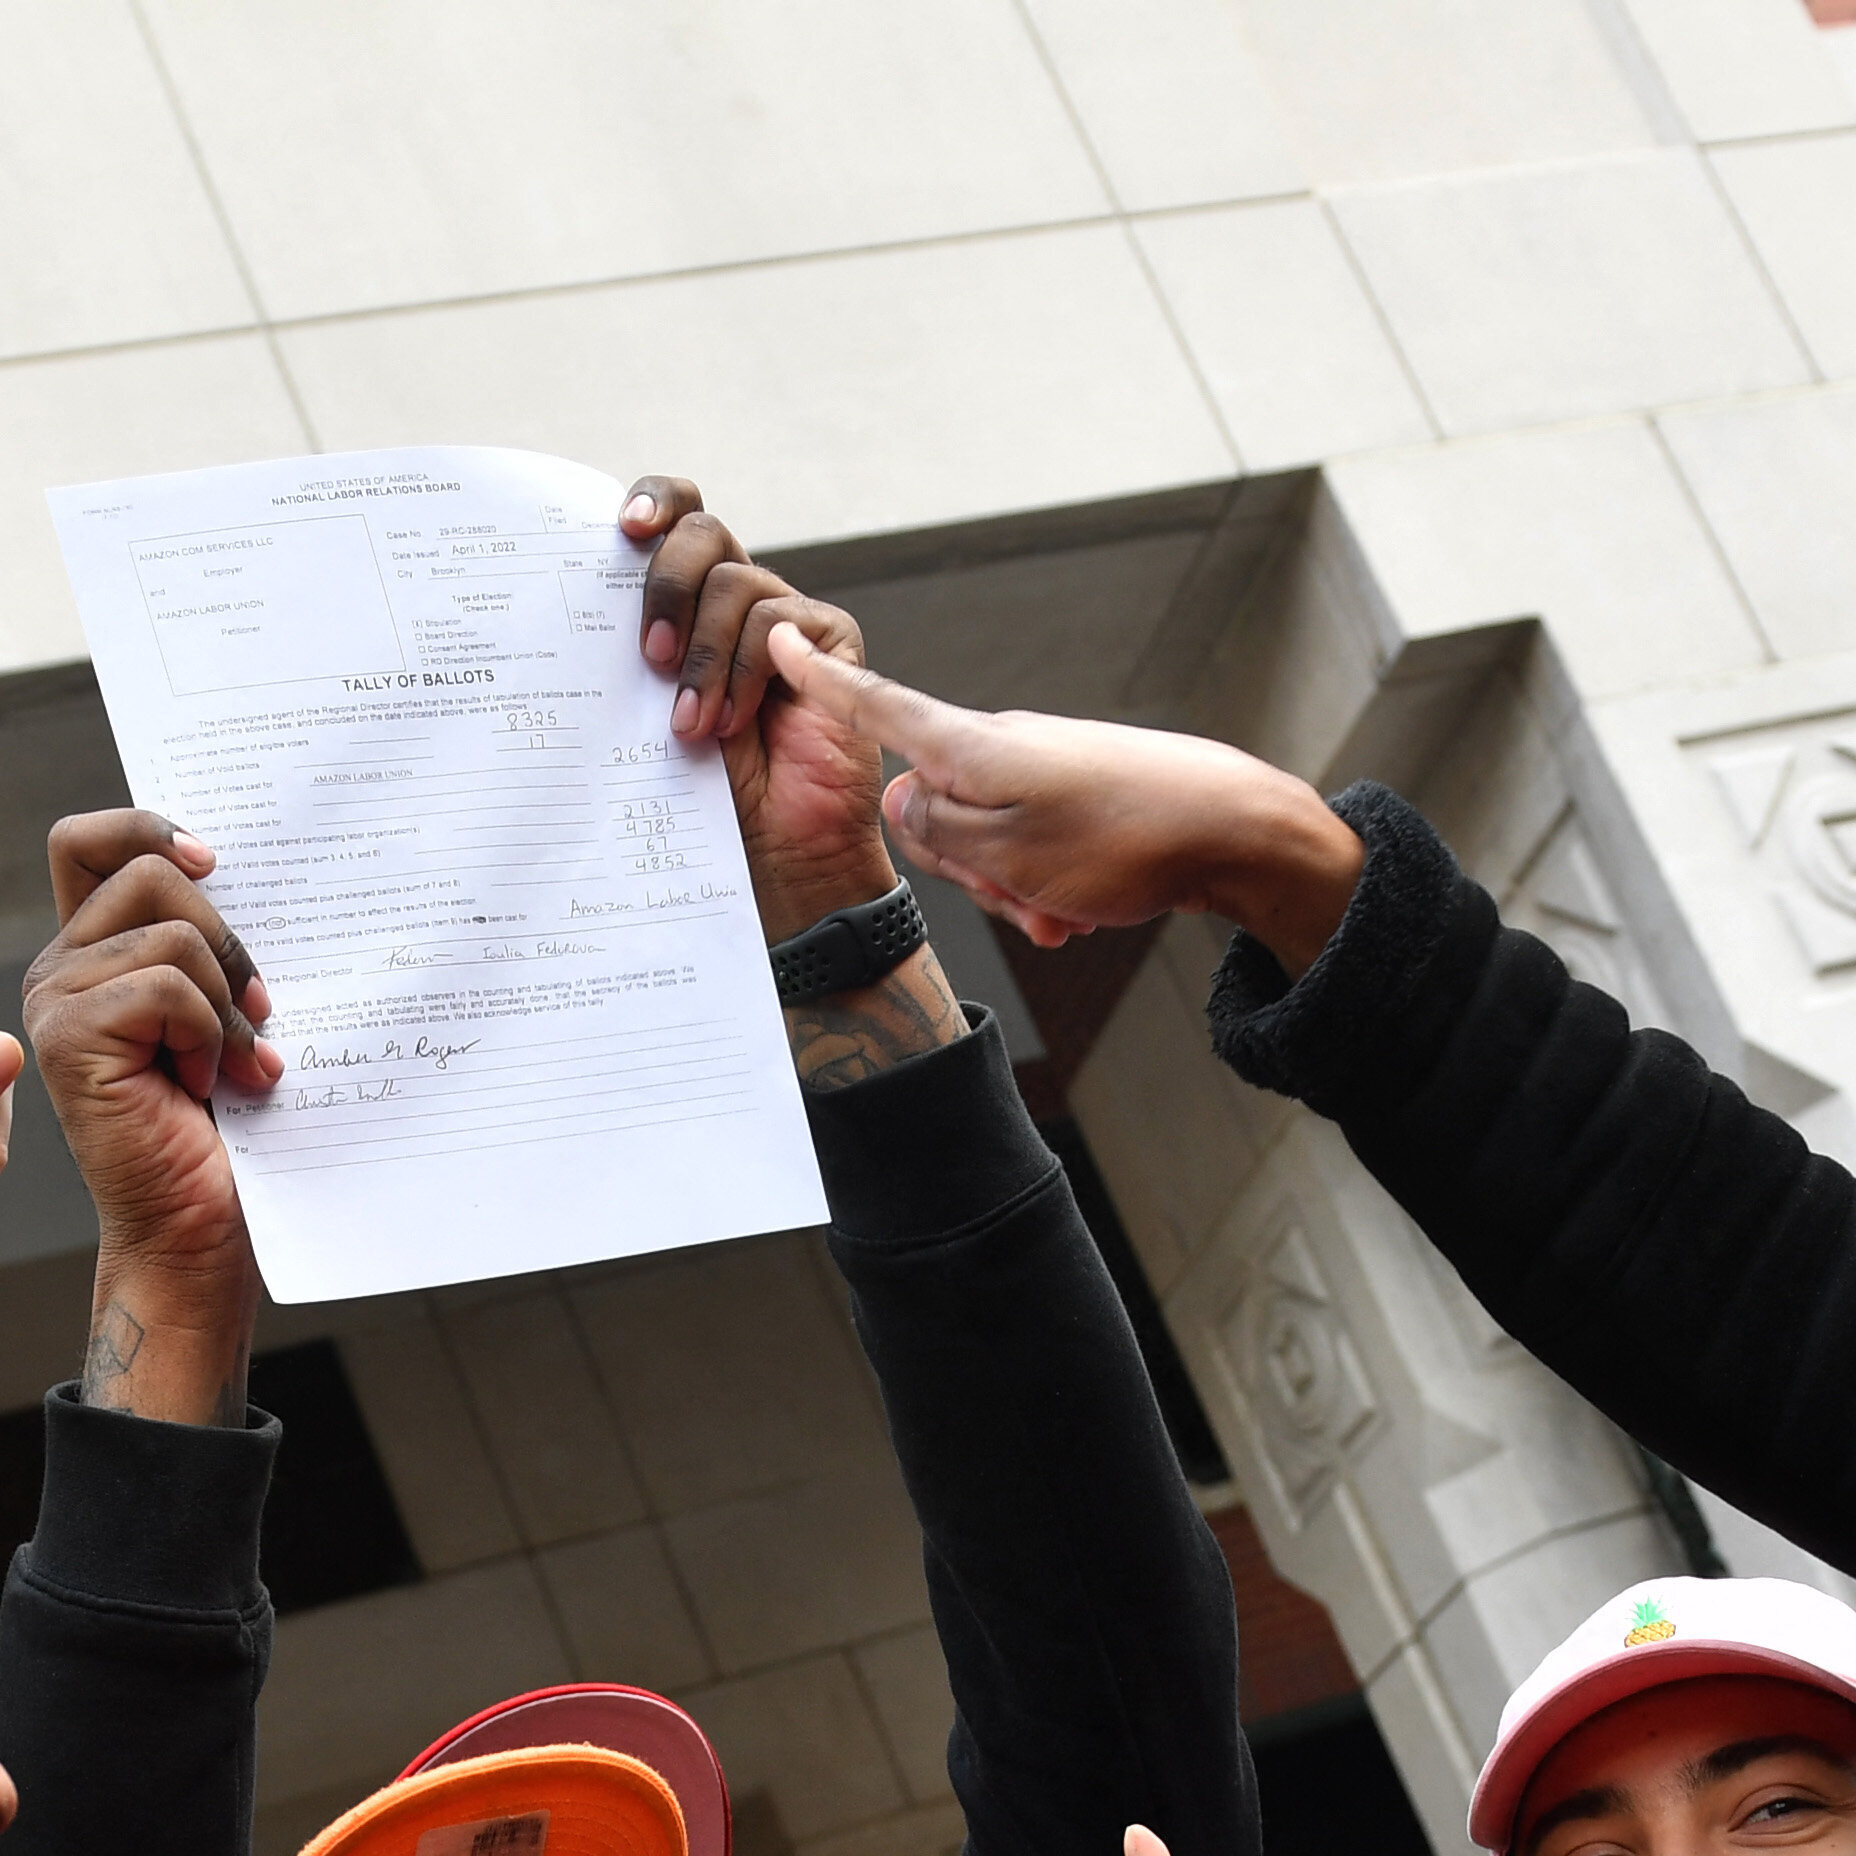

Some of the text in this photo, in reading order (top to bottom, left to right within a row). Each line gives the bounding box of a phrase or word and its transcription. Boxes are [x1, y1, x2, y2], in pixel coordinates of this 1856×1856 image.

[299, 481, 334, 491] UNITED
[336, 478, 371, 488] STATES
[388, 474, 429, 483] AMERICA
[272, 483, 461, 505] NATIONAL LABOR RELATIONS BOARD
[452, 545, 476, 555] April
[490, 542, 517, 552] 2022
[157, 600, 265, 619] AMAZON LABOR UNION
[342, 670, 495, 691] TALLY OF BALLOTS
[507, 710, 557, 731] 8325
[612, 740, 669, 763] 2654
[314, 774, 351, 783] AMAZON
[353, 772, 383, 781] LABOR
[385, 769, 413, 779] UNION
[624, 800, 671, 819] 2131
[646, 836, 668, 852] 67
[570, 898, 634, 918] Amazon
